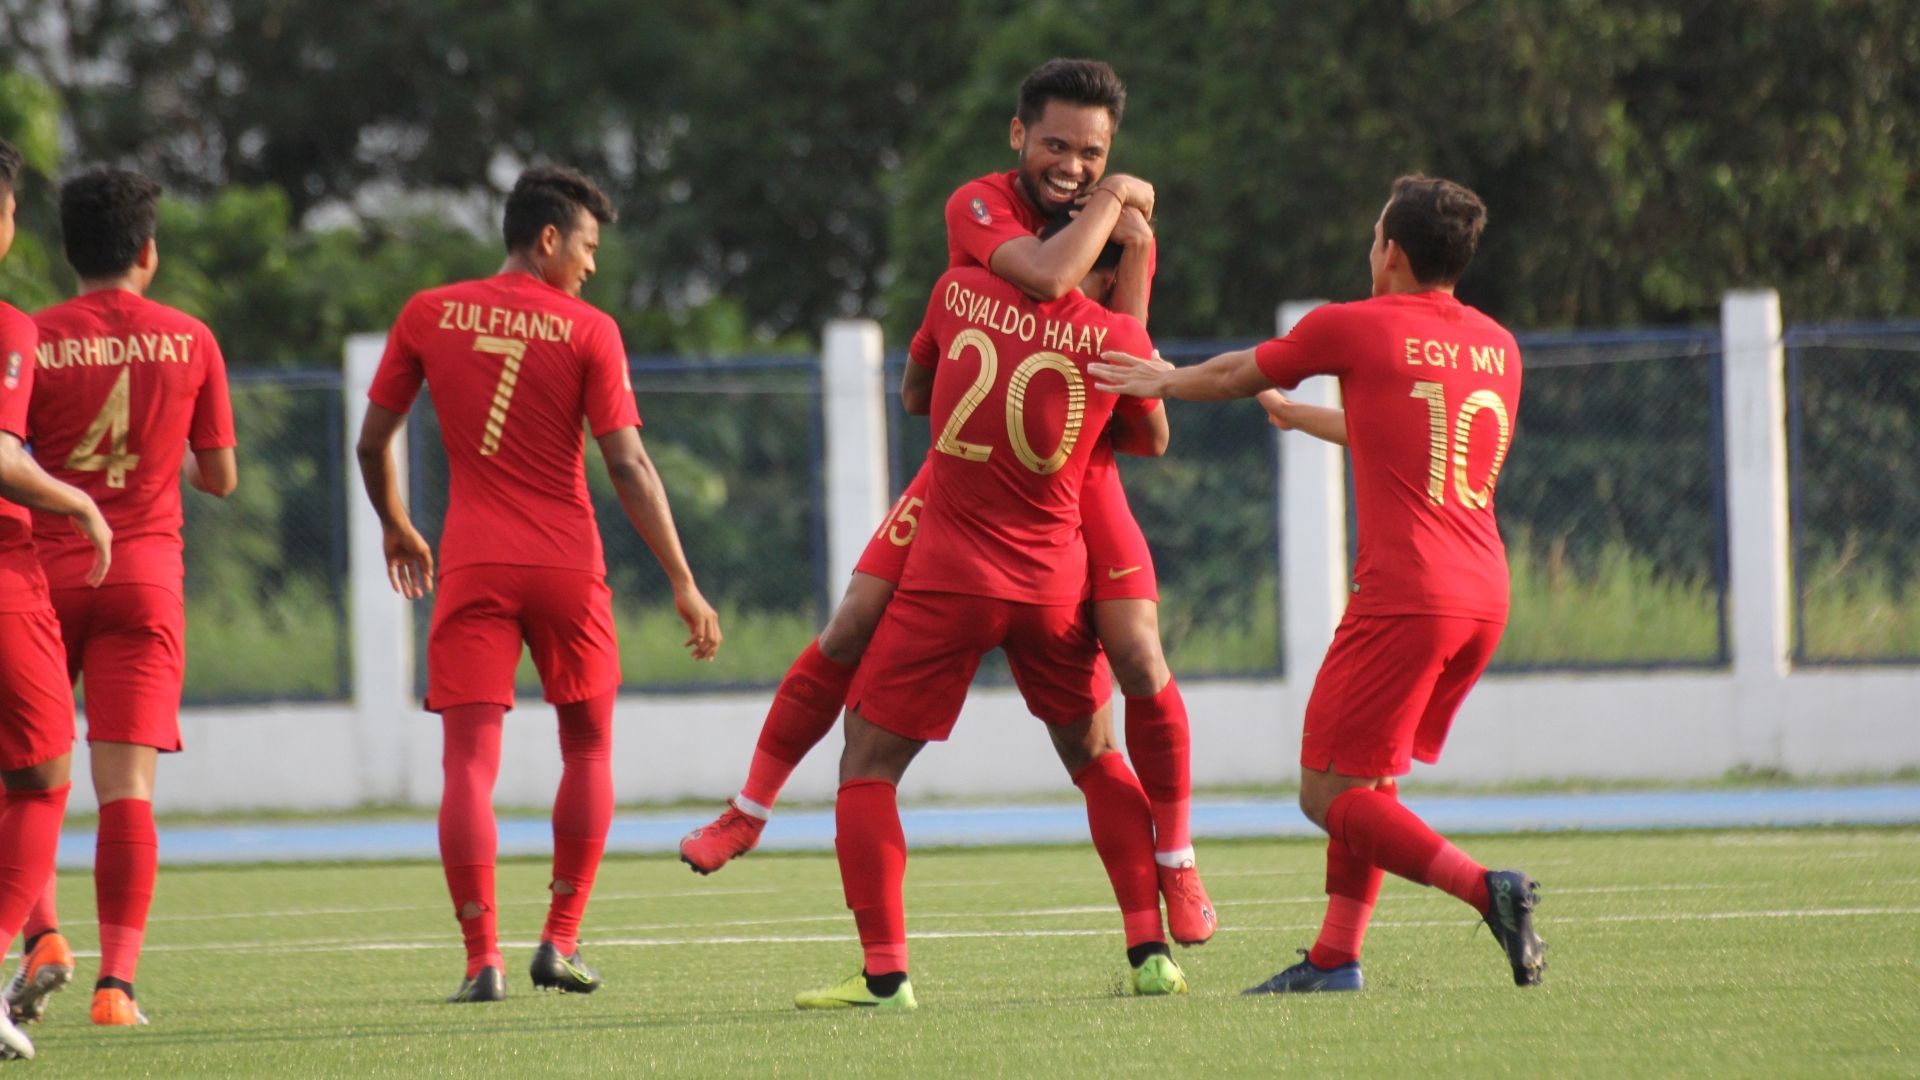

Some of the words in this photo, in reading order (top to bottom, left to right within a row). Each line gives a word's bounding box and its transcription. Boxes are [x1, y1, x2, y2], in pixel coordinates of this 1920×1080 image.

[35, 334, 193, 370] NURHIDAYAT
[439, 301, 573, 343] ZULFIANDI
[945, 281, 1036, 342] OSVALDO
[1043, 320, 1108, 355] HAAY
[1406, 338, 1459, 369] EGY
[1470, 346, 1505, 376] MV
[64, 365, 140, 488] 4
[473, 335, 528, 456] 7
[935, 328, 1086, 475] 20
[1409, 381, 1509, 510] 10
[877, 495, 924, 547] 15
